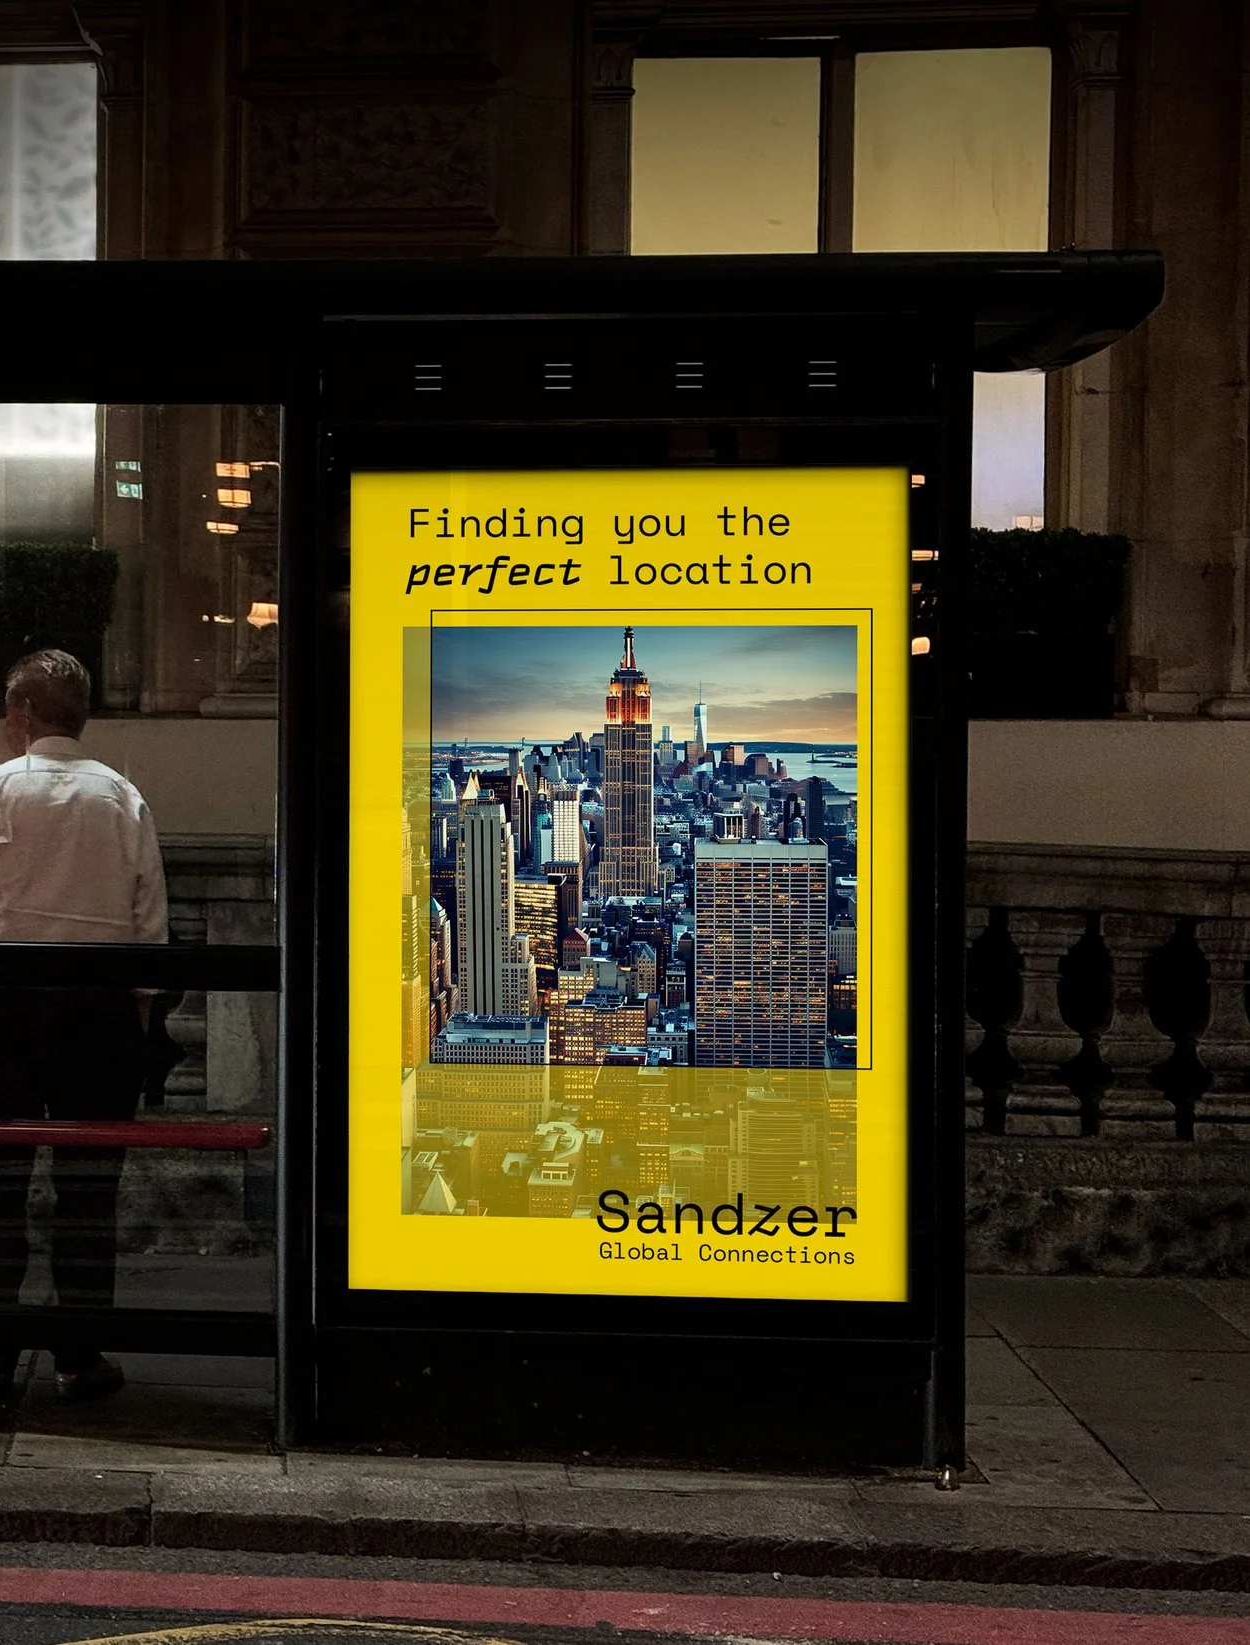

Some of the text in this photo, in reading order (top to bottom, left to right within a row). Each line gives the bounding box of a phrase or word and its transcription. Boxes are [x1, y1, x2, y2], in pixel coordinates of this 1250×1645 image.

[408, 505, 791, 545] Finding you the
[405, 553, 812, 595] perfect location
[596, 1189, 857, 1238] Sandzer
[599, 1241, 856, 1265] Global Connections
